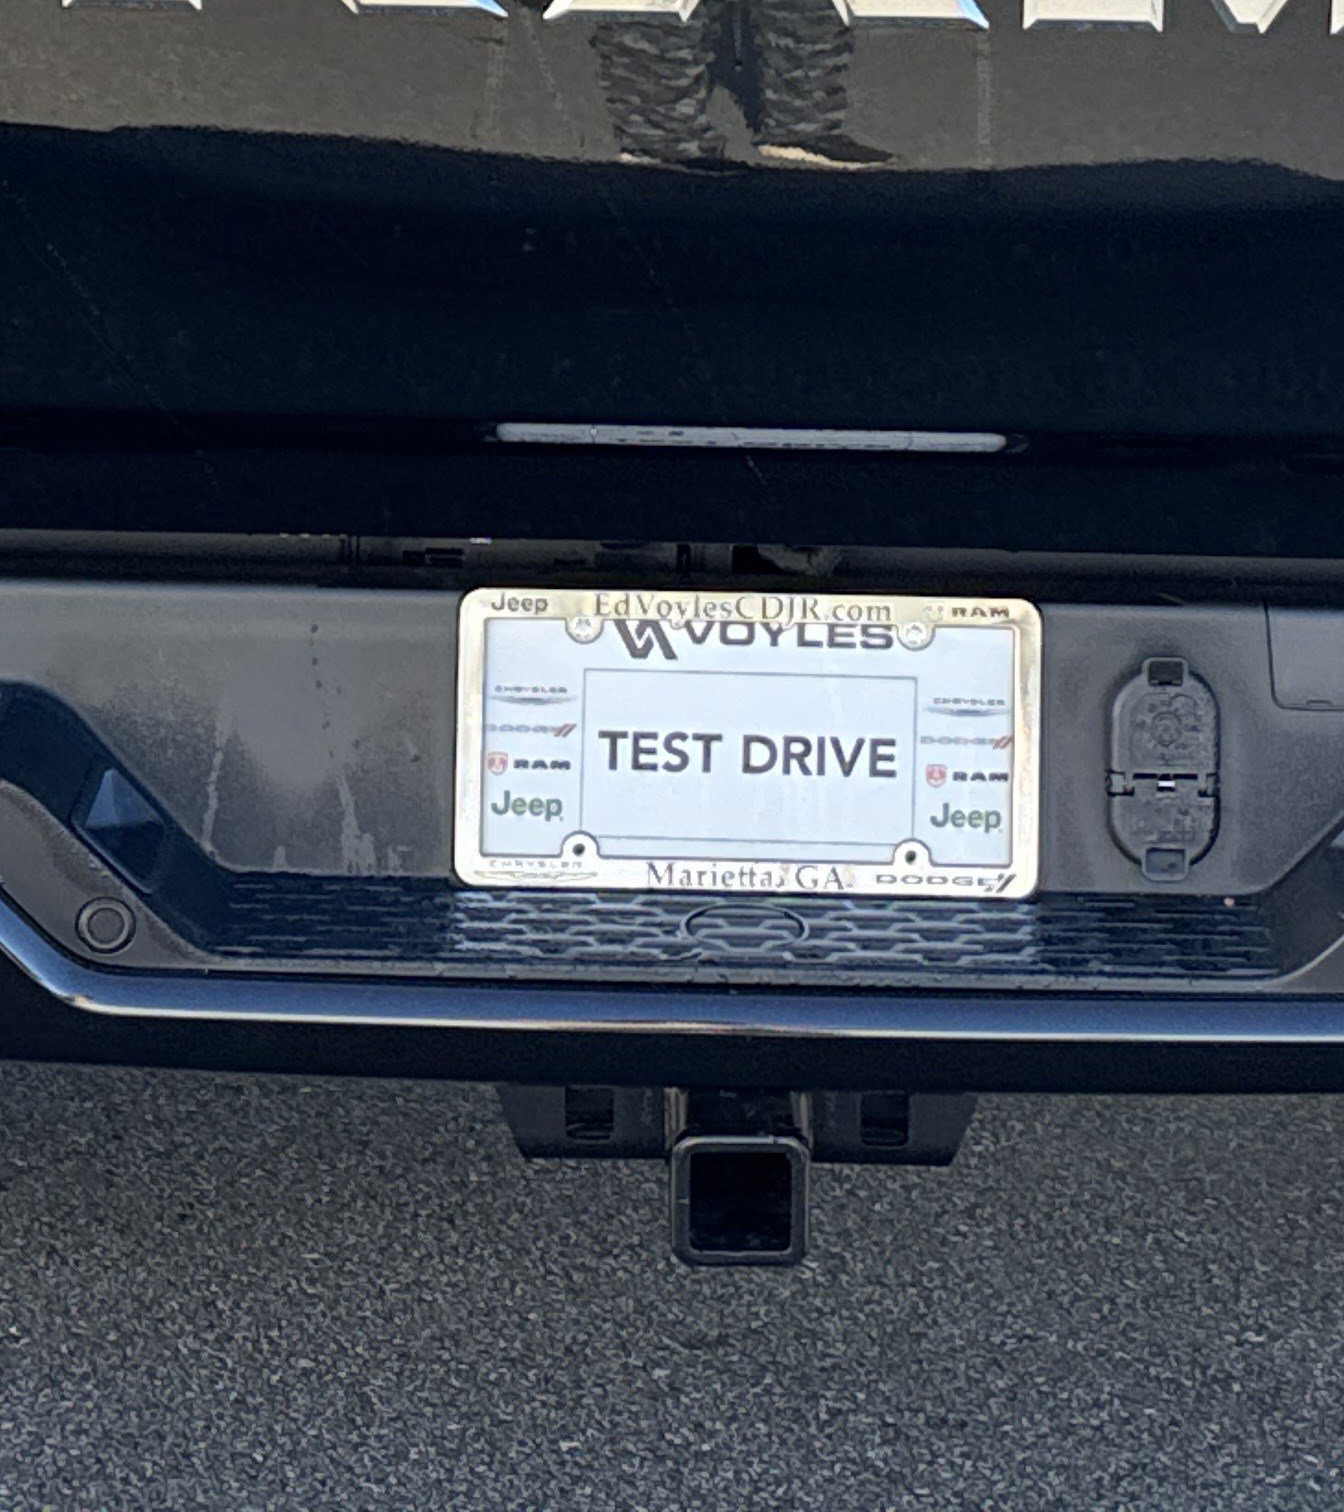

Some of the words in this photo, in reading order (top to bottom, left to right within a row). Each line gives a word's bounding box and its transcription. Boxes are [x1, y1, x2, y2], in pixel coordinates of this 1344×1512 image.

[491, 593, 549, 615] Jeep
[594, 592, 892, 622] EdVoylesCDJR.com
[951, 606, 1010, 619] RAM
[684, 618, 894, 650] VOYLES
[597, 729, 724, 774] TEST
[741, 734, 898, 778] DRIVE
[491, 790, 563, 822] Jeep
[930, 802, 1002, 833] Jeep
